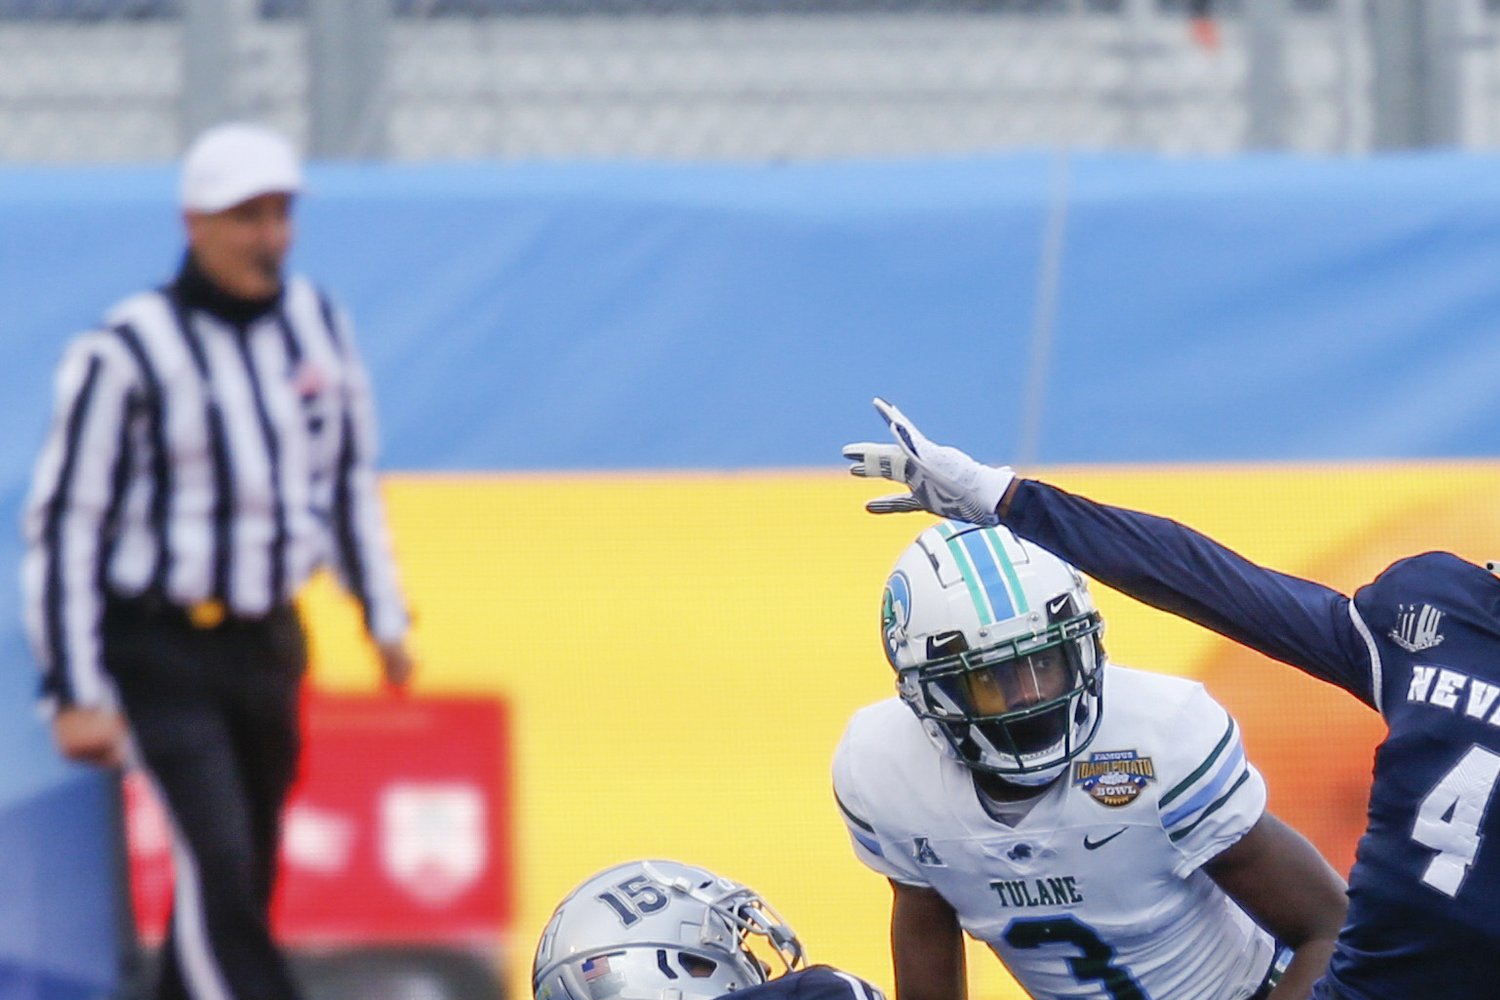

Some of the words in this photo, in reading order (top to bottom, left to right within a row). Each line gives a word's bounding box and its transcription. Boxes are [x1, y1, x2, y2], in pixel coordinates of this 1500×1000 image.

[1094, 751, 1134, 762] FAMOUS
[1096, 785, 1137, 797] BOWL
[595, 873, 669, 928] 15
[989, 876, 1084, 907] TULANE
